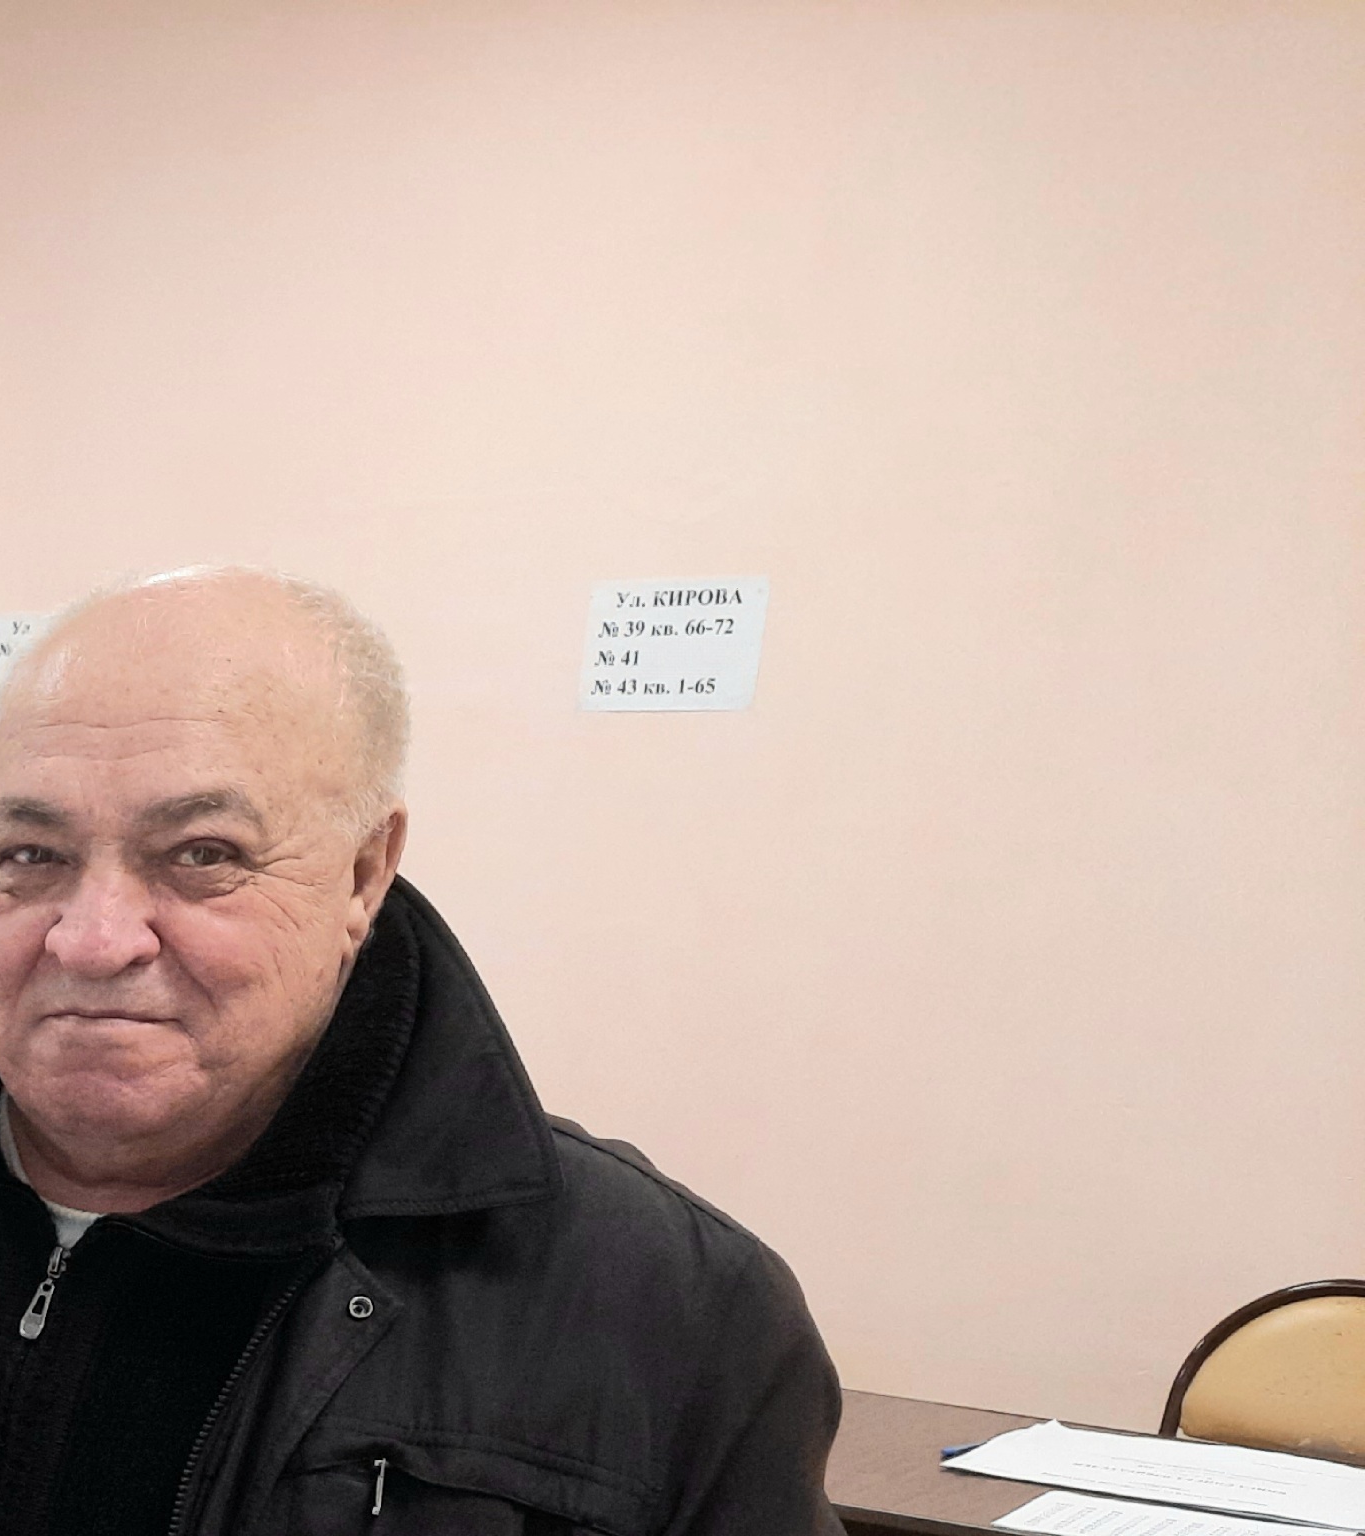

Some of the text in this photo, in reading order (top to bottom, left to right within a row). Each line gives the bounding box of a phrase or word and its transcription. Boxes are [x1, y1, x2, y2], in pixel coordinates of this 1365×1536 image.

[616, 588, 743, 608] Ул. КИРОВА
[598, 618, 735, 638] № 39 кв. 66-72
[594, 650, 640, 667] № 41
[590, 677, 717, 696] № 43 кв. 1-65
